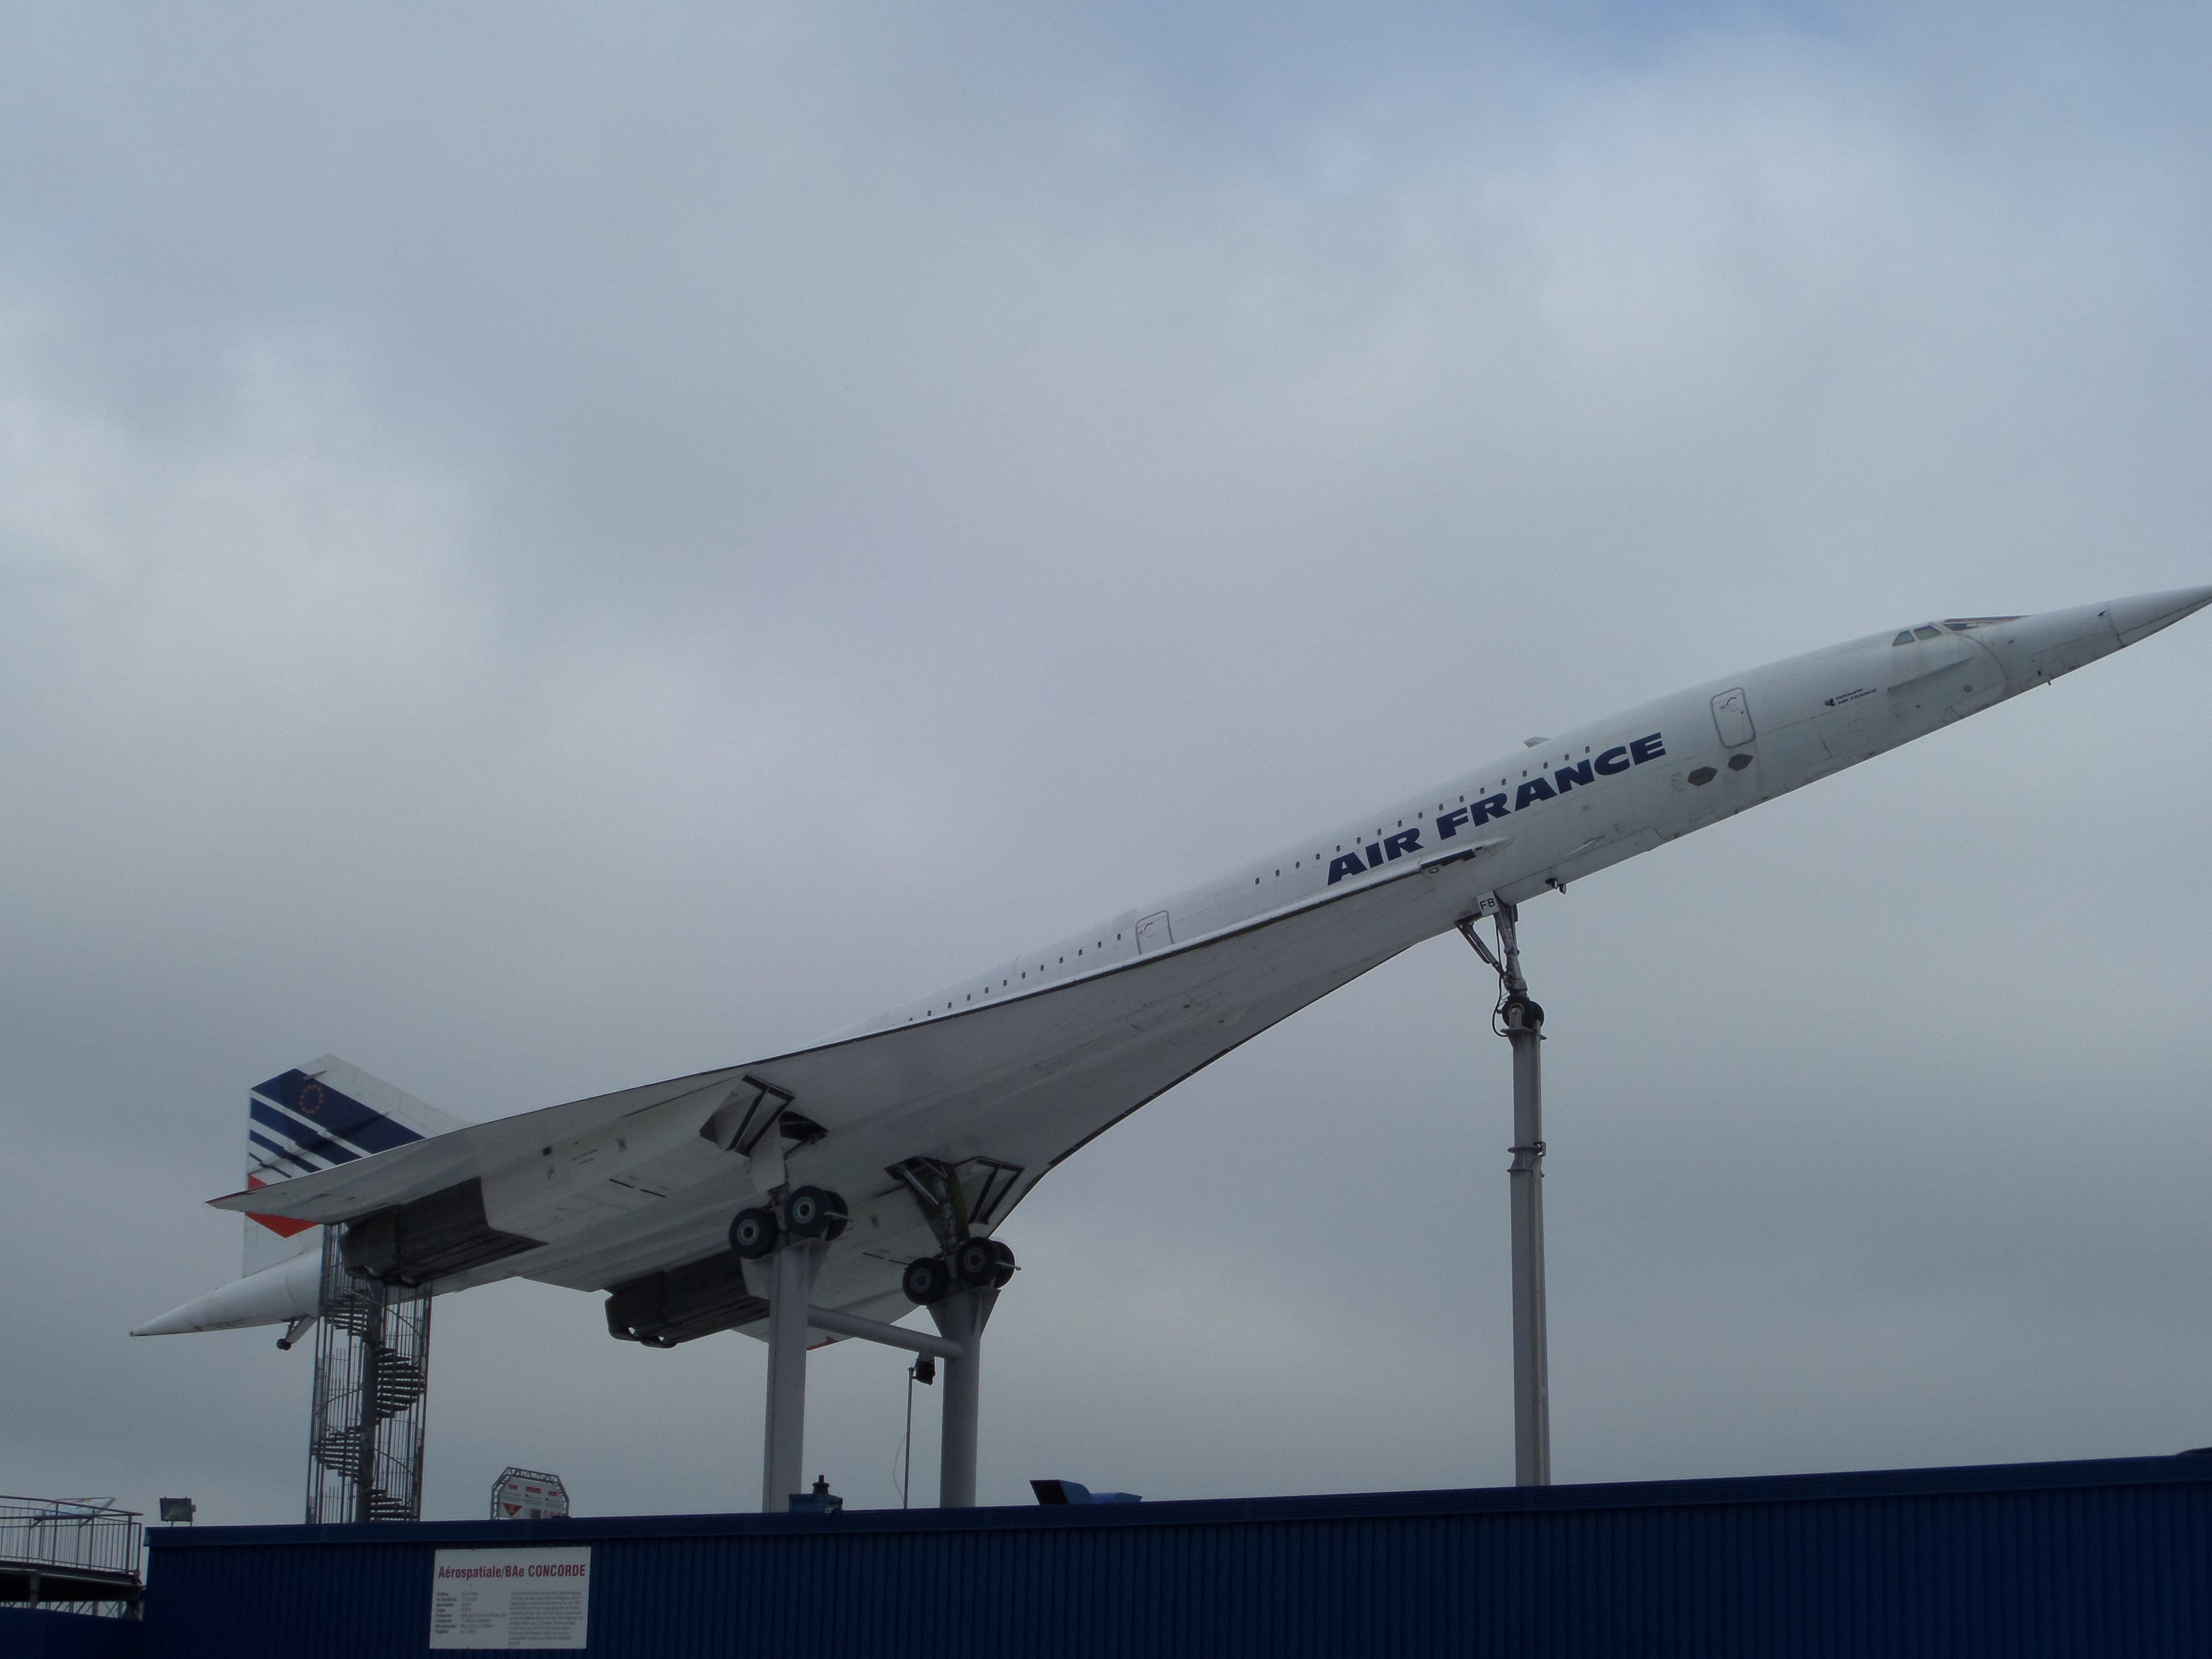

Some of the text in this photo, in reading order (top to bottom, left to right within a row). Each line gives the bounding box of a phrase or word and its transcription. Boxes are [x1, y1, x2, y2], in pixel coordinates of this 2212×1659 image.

[1850, 688, 1877, 699] FRANCE
[1327, 732, 1667, 886] AIR FRANCE
[1479, 898, 1496, 910] FB
[438, 1564, 586, 1580] Aérospatiale/BAe CONCORDE
